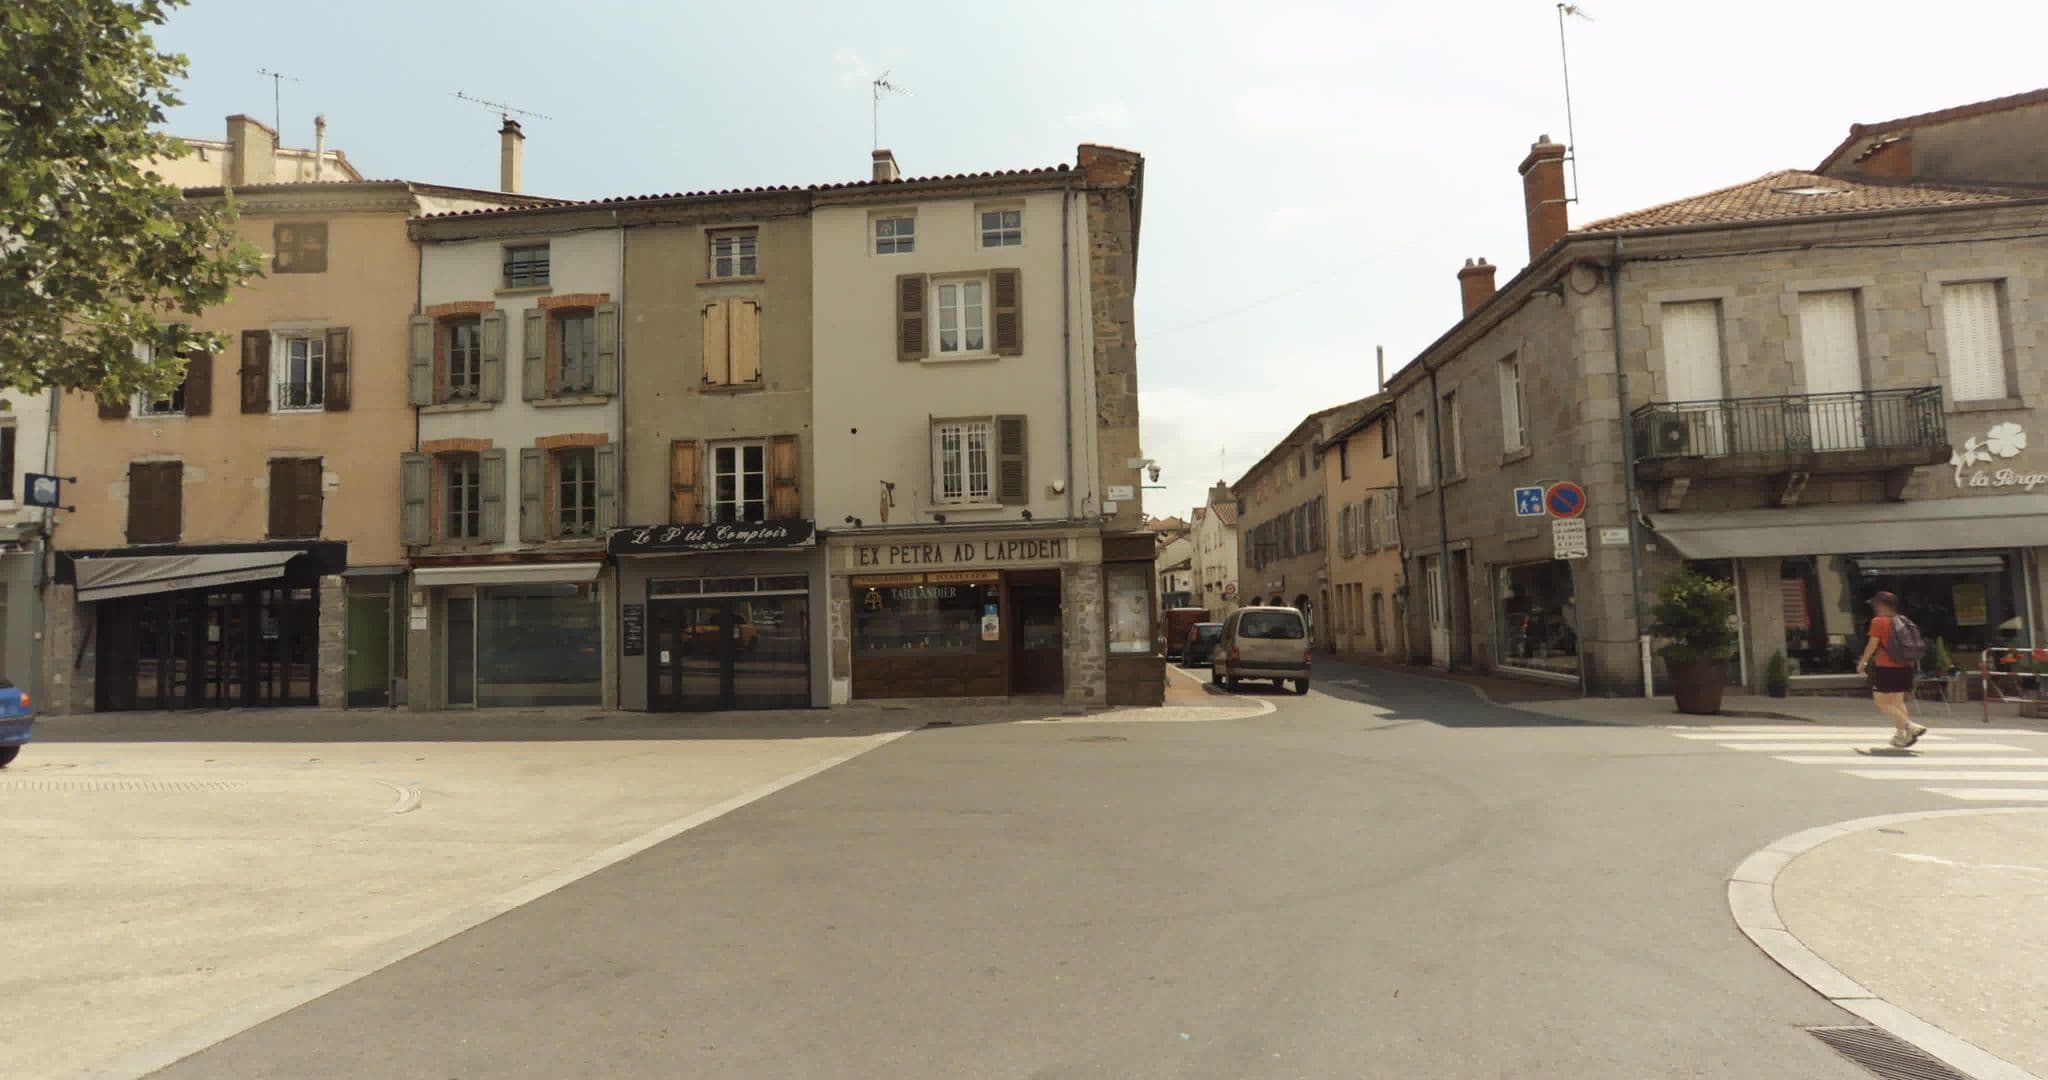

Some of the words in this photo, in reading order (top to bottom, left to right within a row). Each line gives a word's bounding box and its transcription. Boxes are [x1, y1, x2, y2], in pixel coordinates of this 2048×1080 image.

[631, 527, 650, 544] Le
[660, 525, 705, 543] P'tit
[716, 524, 787, 544] Comptoir
[860, 546, 879, 566] EX
[889, 543, 944, 564] PETRA
[954, 543, 974, 562] AD
[984, 538, 1061, 561] LAPIDEM
[891, 586, 957, 600] TAILLANDIER
